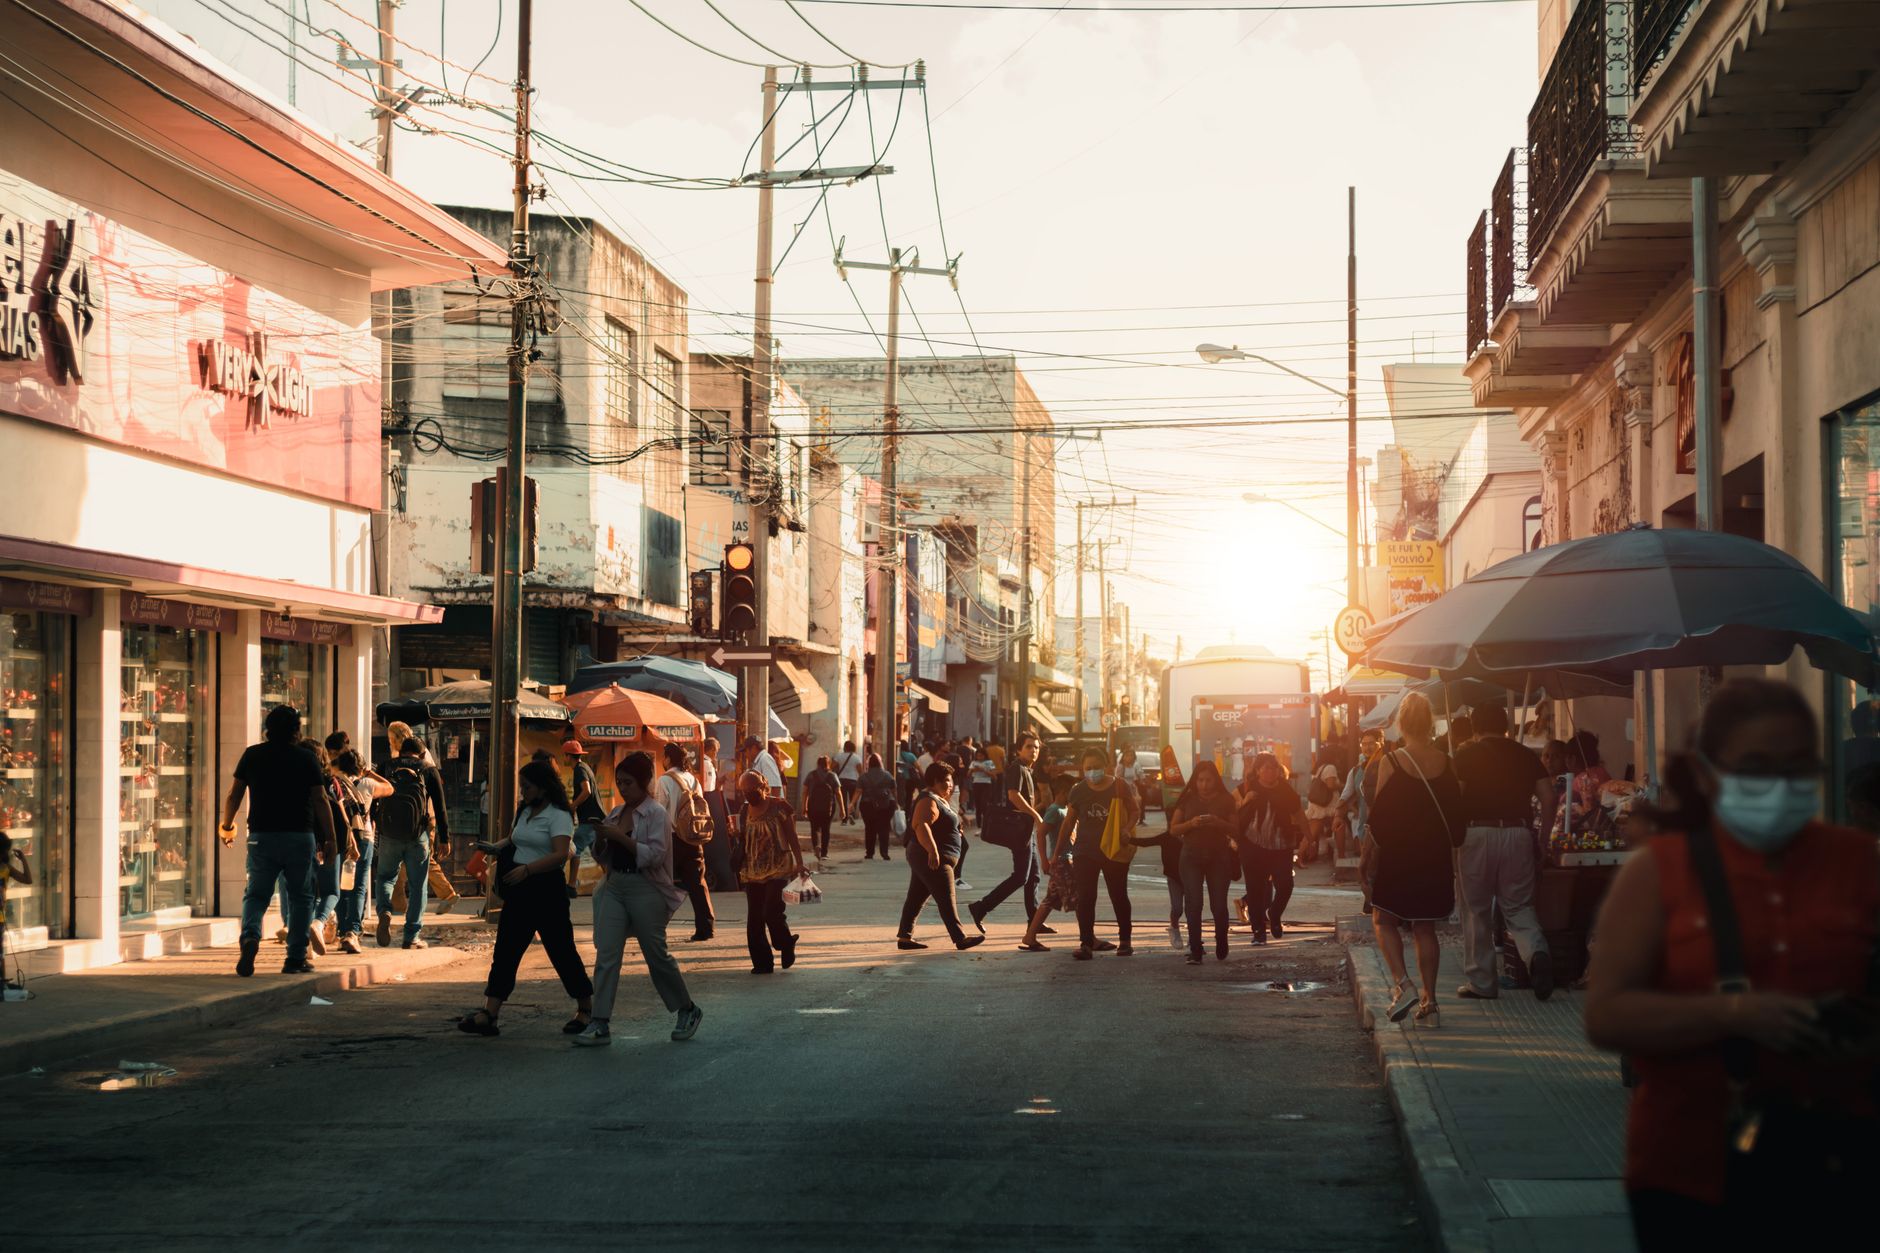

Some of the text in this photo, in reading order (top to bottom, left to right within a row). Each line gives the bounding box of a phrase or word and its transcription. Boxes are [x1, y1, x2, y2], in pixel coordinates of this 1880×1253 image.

[214, 339, 313, 417] VERY LIGHT
[1387, 544, 1421, 553] SE FUE Y
[1344, 615, 1367, 638] 30
[1213, 711, 1241, 721] GEPP
[590, 727, 634, 736] ¡Al chile!
[659, 727, 692, 737] ¡Al chile!
